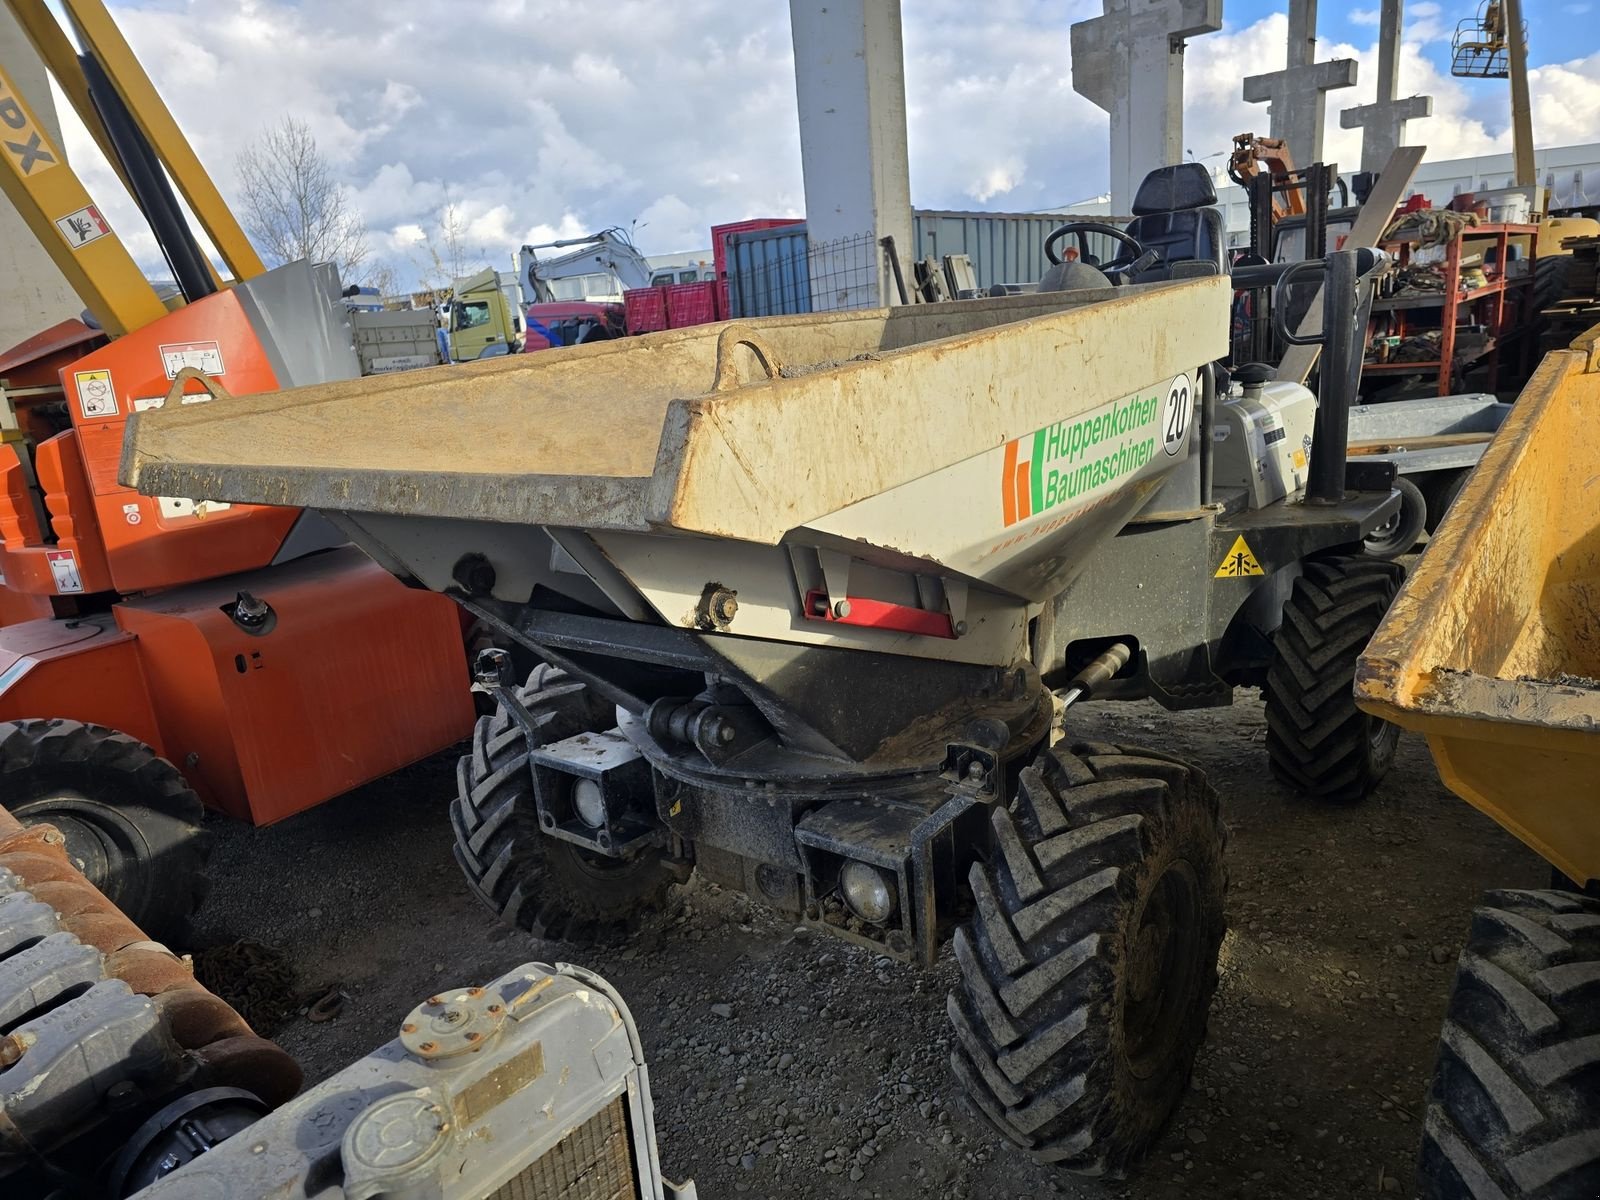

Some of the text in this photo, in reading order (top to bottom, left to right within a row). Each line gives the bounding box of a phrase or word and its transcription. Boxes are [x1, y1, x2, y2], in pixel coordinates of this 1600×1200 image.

[1046, 395, 1158, 464] Huppenkothen
[1165, 387, 1187, 443] 20
[1044, 437, 1154, 510] Baumaschinen
